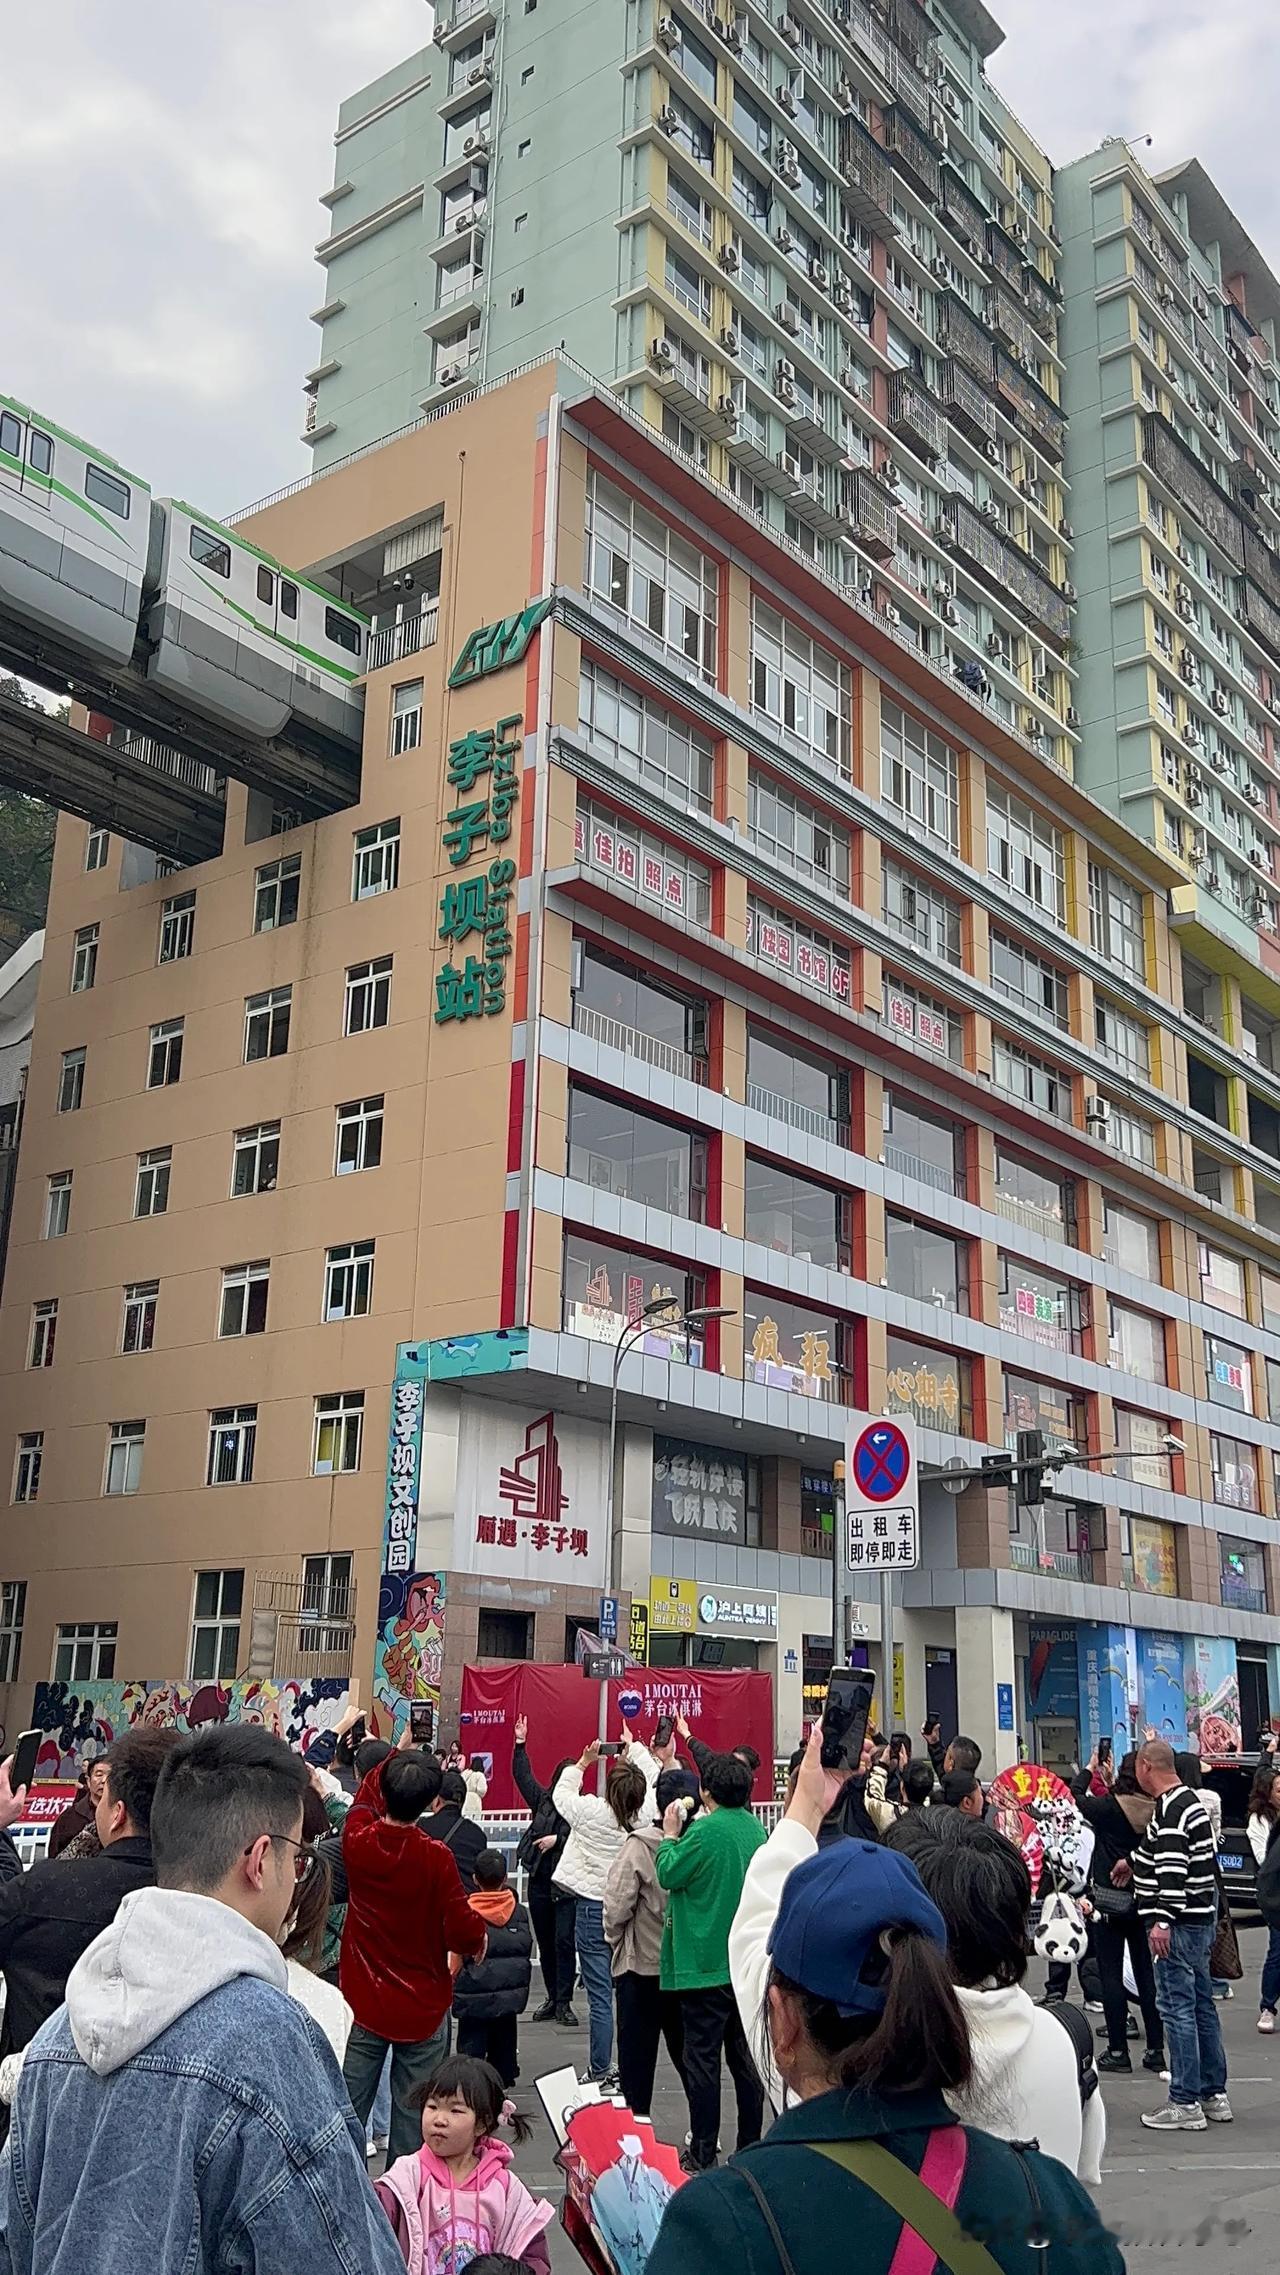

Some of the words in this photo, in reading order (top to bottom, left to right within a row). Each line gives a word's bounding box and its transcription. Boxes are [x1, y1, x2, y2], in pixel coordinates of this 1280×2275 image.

[491, 713, 523, 843] Liziba
[434, 729, 494, 1026] 李子坝站
[484, 858, 517, 1016] Station
[387, 1381, 420, 1572] 李子坝文创园
[851, 1514, 912, 1538] 出租车
[851, 1539, 913, 1564] 即停即走
[604, 1600, 614, 1619] P
[718, 1600, 767, 1619] 沪上阿姨
[644, 1699, 703, 1718] 茅台冰淇淋
